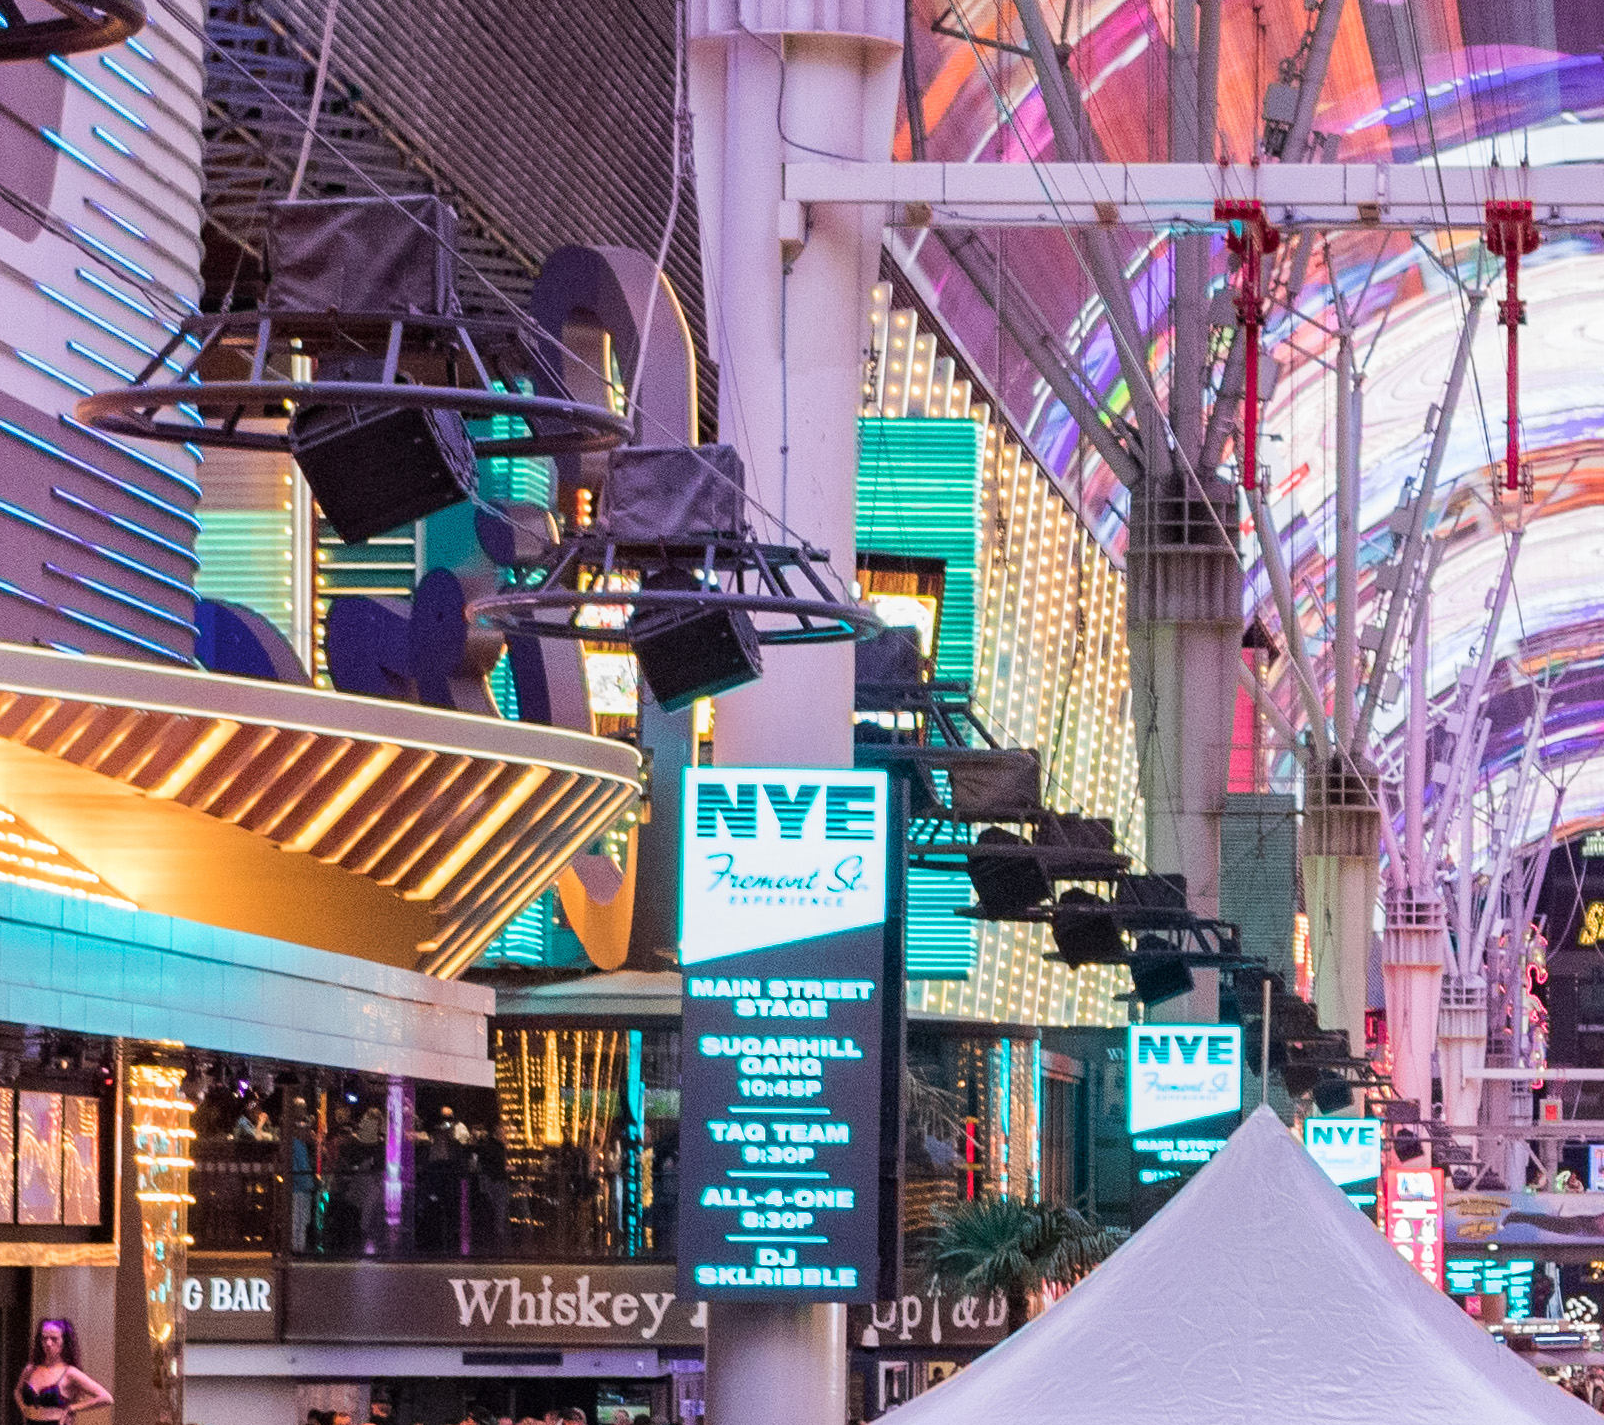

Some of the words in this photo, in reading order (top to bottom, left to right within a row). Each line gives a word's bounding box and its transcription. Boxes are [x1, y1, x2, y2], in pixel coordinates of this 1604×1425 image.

[696, 783, 876, 840] NYE
[706, 853, 819, 892] Fremont
[827, 854, 870, 893] St.
[730, 894, 845, 907] EXPERIENCE
[689, 978, 763, 1000] MAIN
[766, 978, 875, 1001] STREET
[734, 999, 828, 1019] STAGE
[699, 1036, 863, 1059] SUGARHILL
[1137, 1035, 1234, 1065] NYE
[739, 1057, 824, 1078] GANG
[738, 1079, 821, 1099] 10:45P
[707, 1122, 772, 1143] TAG
[775, 1122, 850, 1143] TEAM
[1312, 1126, 1375, 1146] NYE
[741, 1145, 815, 1164] 9:30P
[701, 1187, 854, 1211] ALL-4-ONE
[756, 1247, 798, 1268] DJ
[695, 1267, 858, 1288] SKLRIBBLE
[209, 1276, 272, 1315] BAR
[451, 1274, 676, 1338] Whiskey
